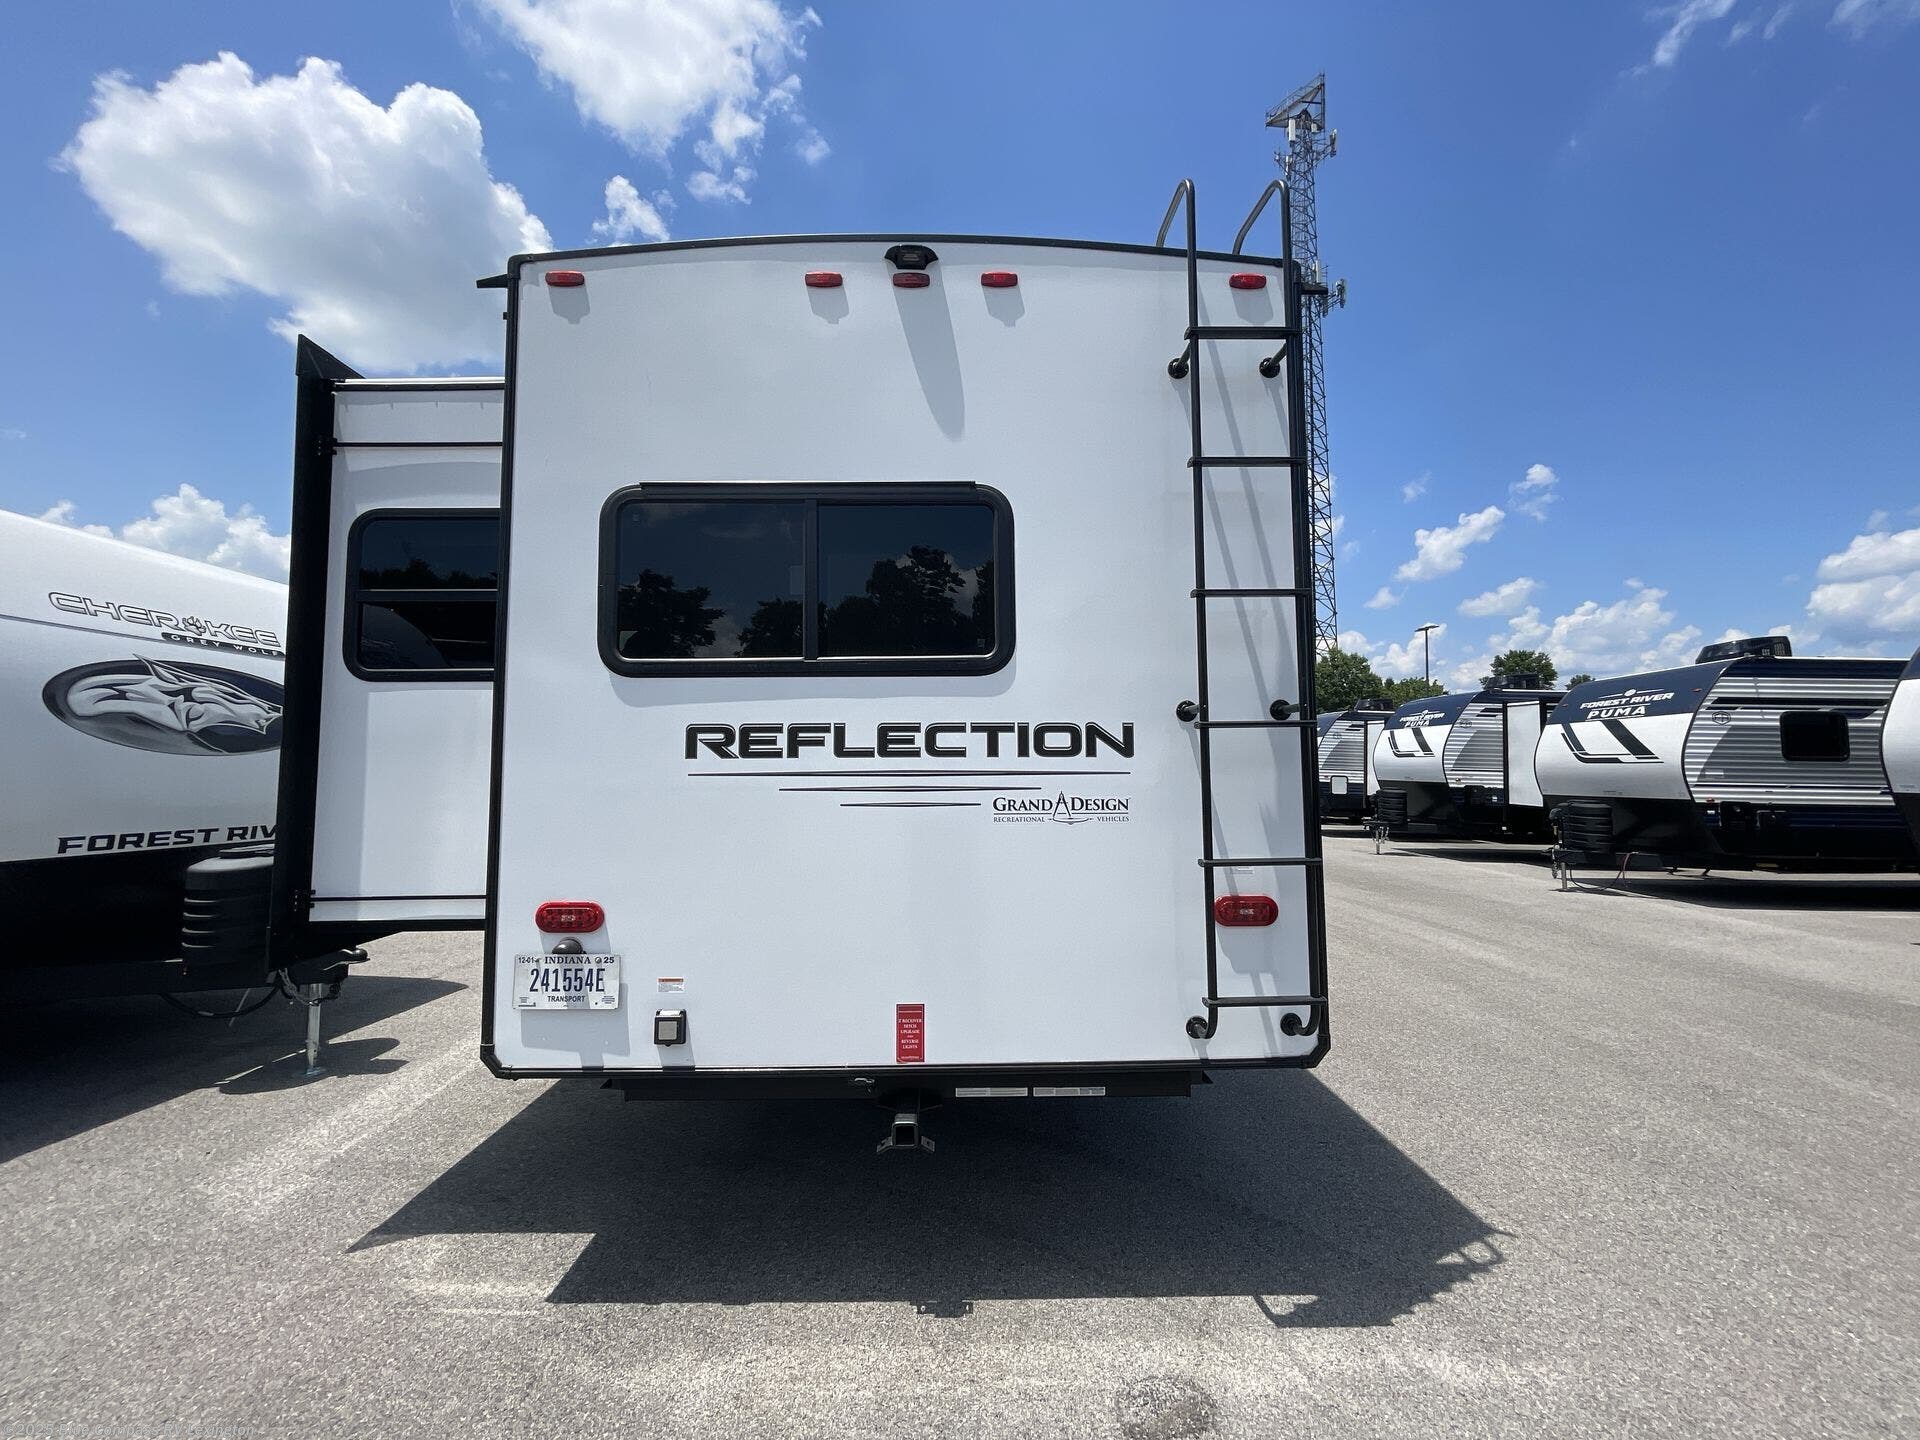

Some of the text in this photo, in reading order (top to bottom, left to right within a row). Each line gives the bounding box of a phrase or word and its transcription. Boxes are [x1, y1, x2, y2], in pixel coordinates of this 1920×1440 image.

[233, 644, 279, 656] WOLF
[1580, 692, 1675, 709] FOREST RIVER
[1586, 706, 1646, 719] PUMA
[684, 722, 1135, 759] REFLECTION
[993, 797, 1130, 811] GRAND DESIGN
[57, 825, 277, 854] FOREST RIV
[545, 956, 591, 964] INDIANA
[603, 956, 615, 964] 25
[529, 968, 605, 992] 241554E
